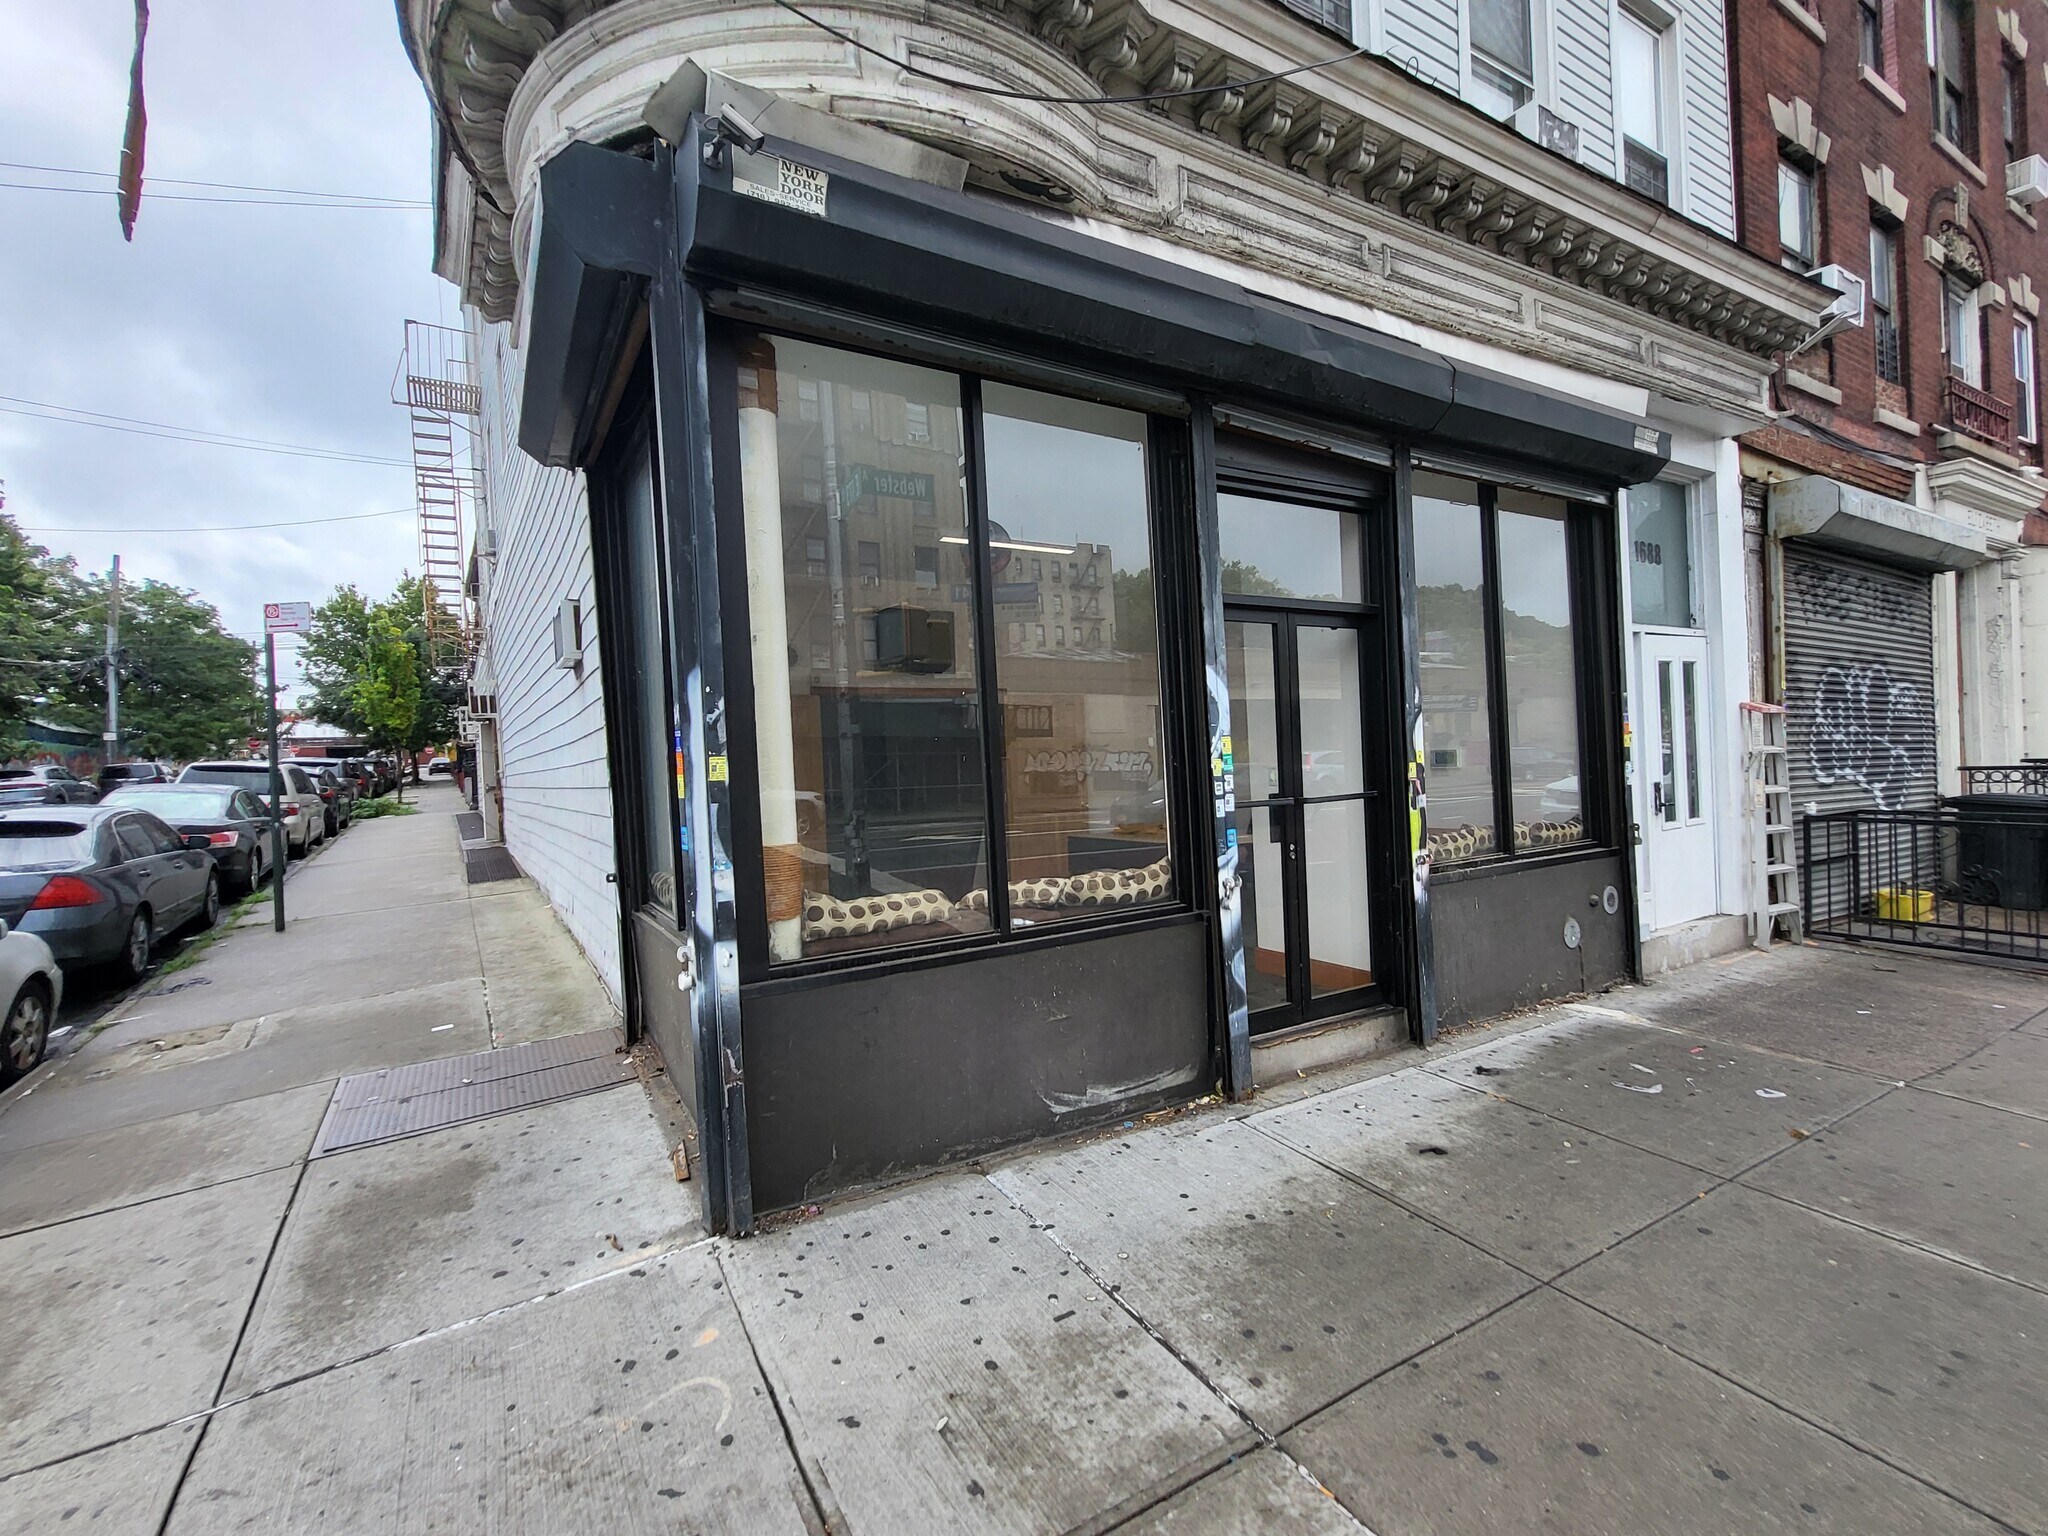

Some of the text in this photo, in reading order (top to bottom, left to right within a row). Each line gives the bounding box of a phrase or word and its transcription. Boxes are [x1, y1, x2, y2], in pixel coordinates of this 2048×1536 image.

[781, 160, 820, 181] NEW
[746, 188, 770, 202] (718)
[781, 174, 825, 196] YORK
[781, 183, 824, 206] DOOR
[1634, 540, 1662, 565] 1688
